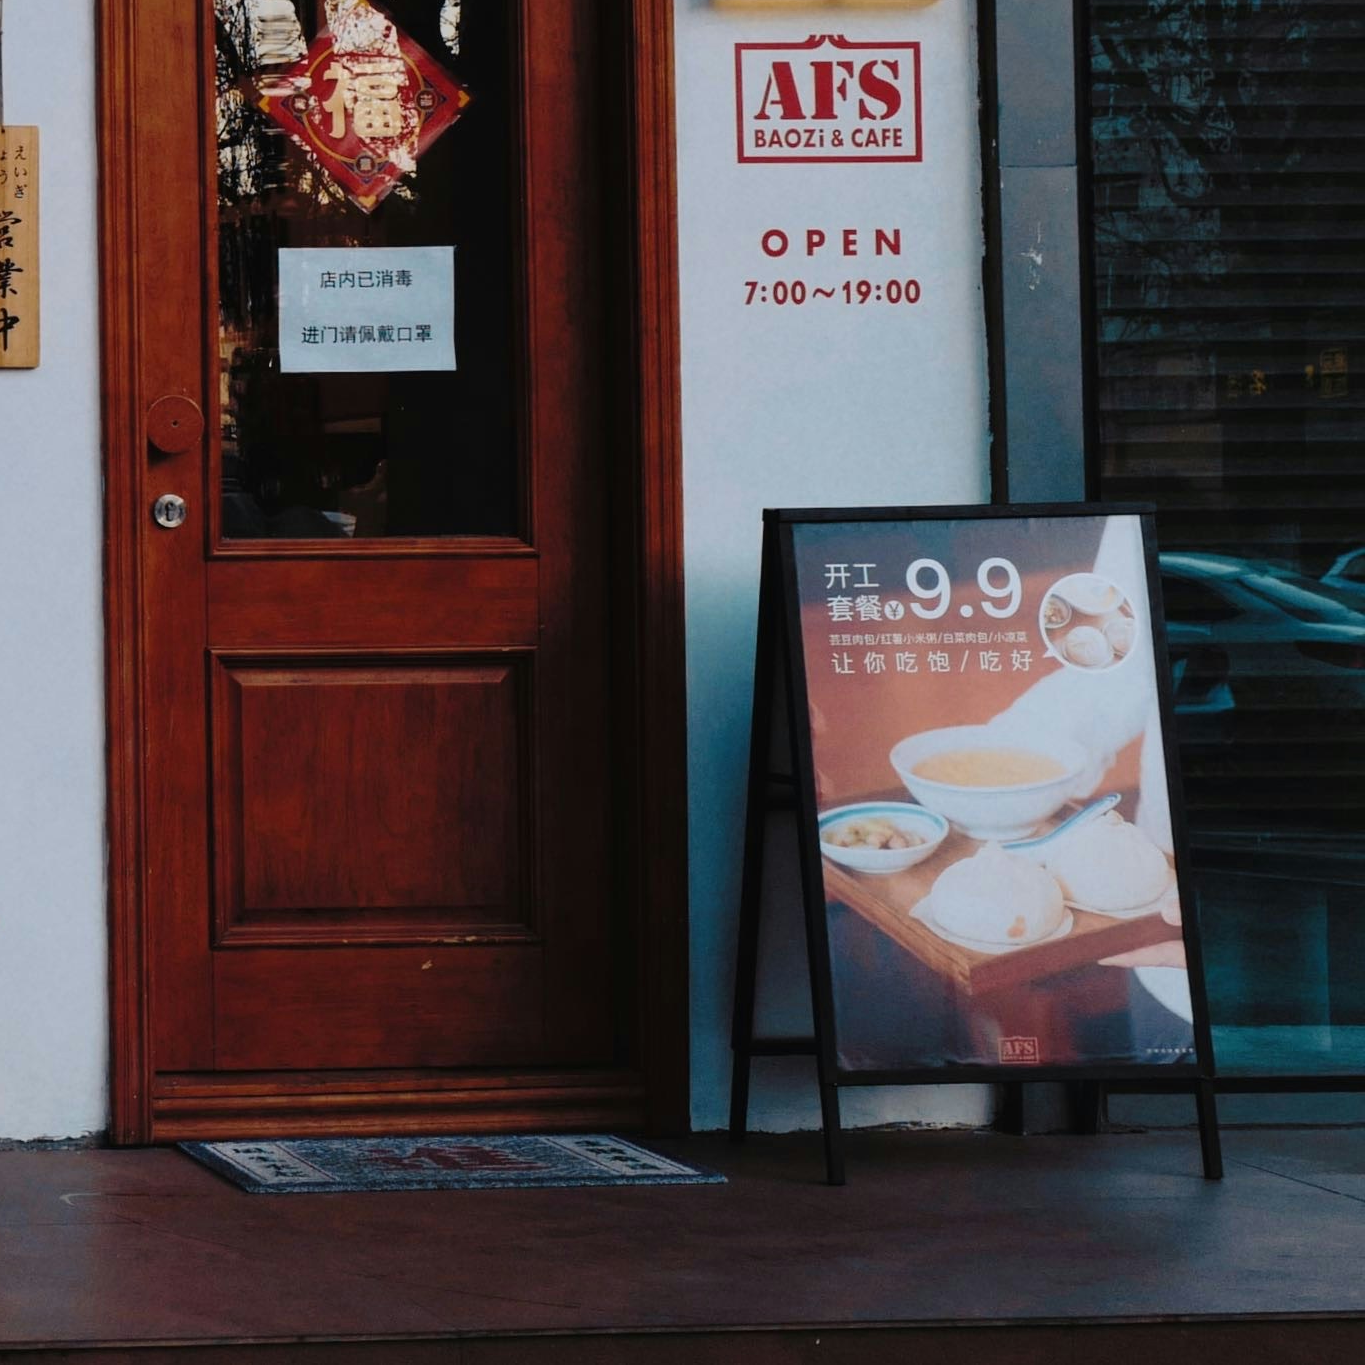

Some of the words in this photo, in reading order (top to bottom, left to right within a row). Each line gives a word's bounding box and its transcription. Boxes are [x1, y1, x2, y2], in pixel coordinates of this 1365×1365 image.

[322, 62, 409, 139] 福
[753, 59, 903, 121] AFS
[831, 128, 844, 148] &
[851, 127, 903, 148] CAFE
[13, 145, 28, 199] えいぎ
[761, 229, 901, 257] OPEN
[320, 269, 414, 289] 店内已消毒
[301, 324, 433, 344] 进门请佩戴口罩
[824, 563, 881, 589] 开工
[827, 594, 883, 622] 套餐
[1004, 1040, 1034, 1055] AFS
